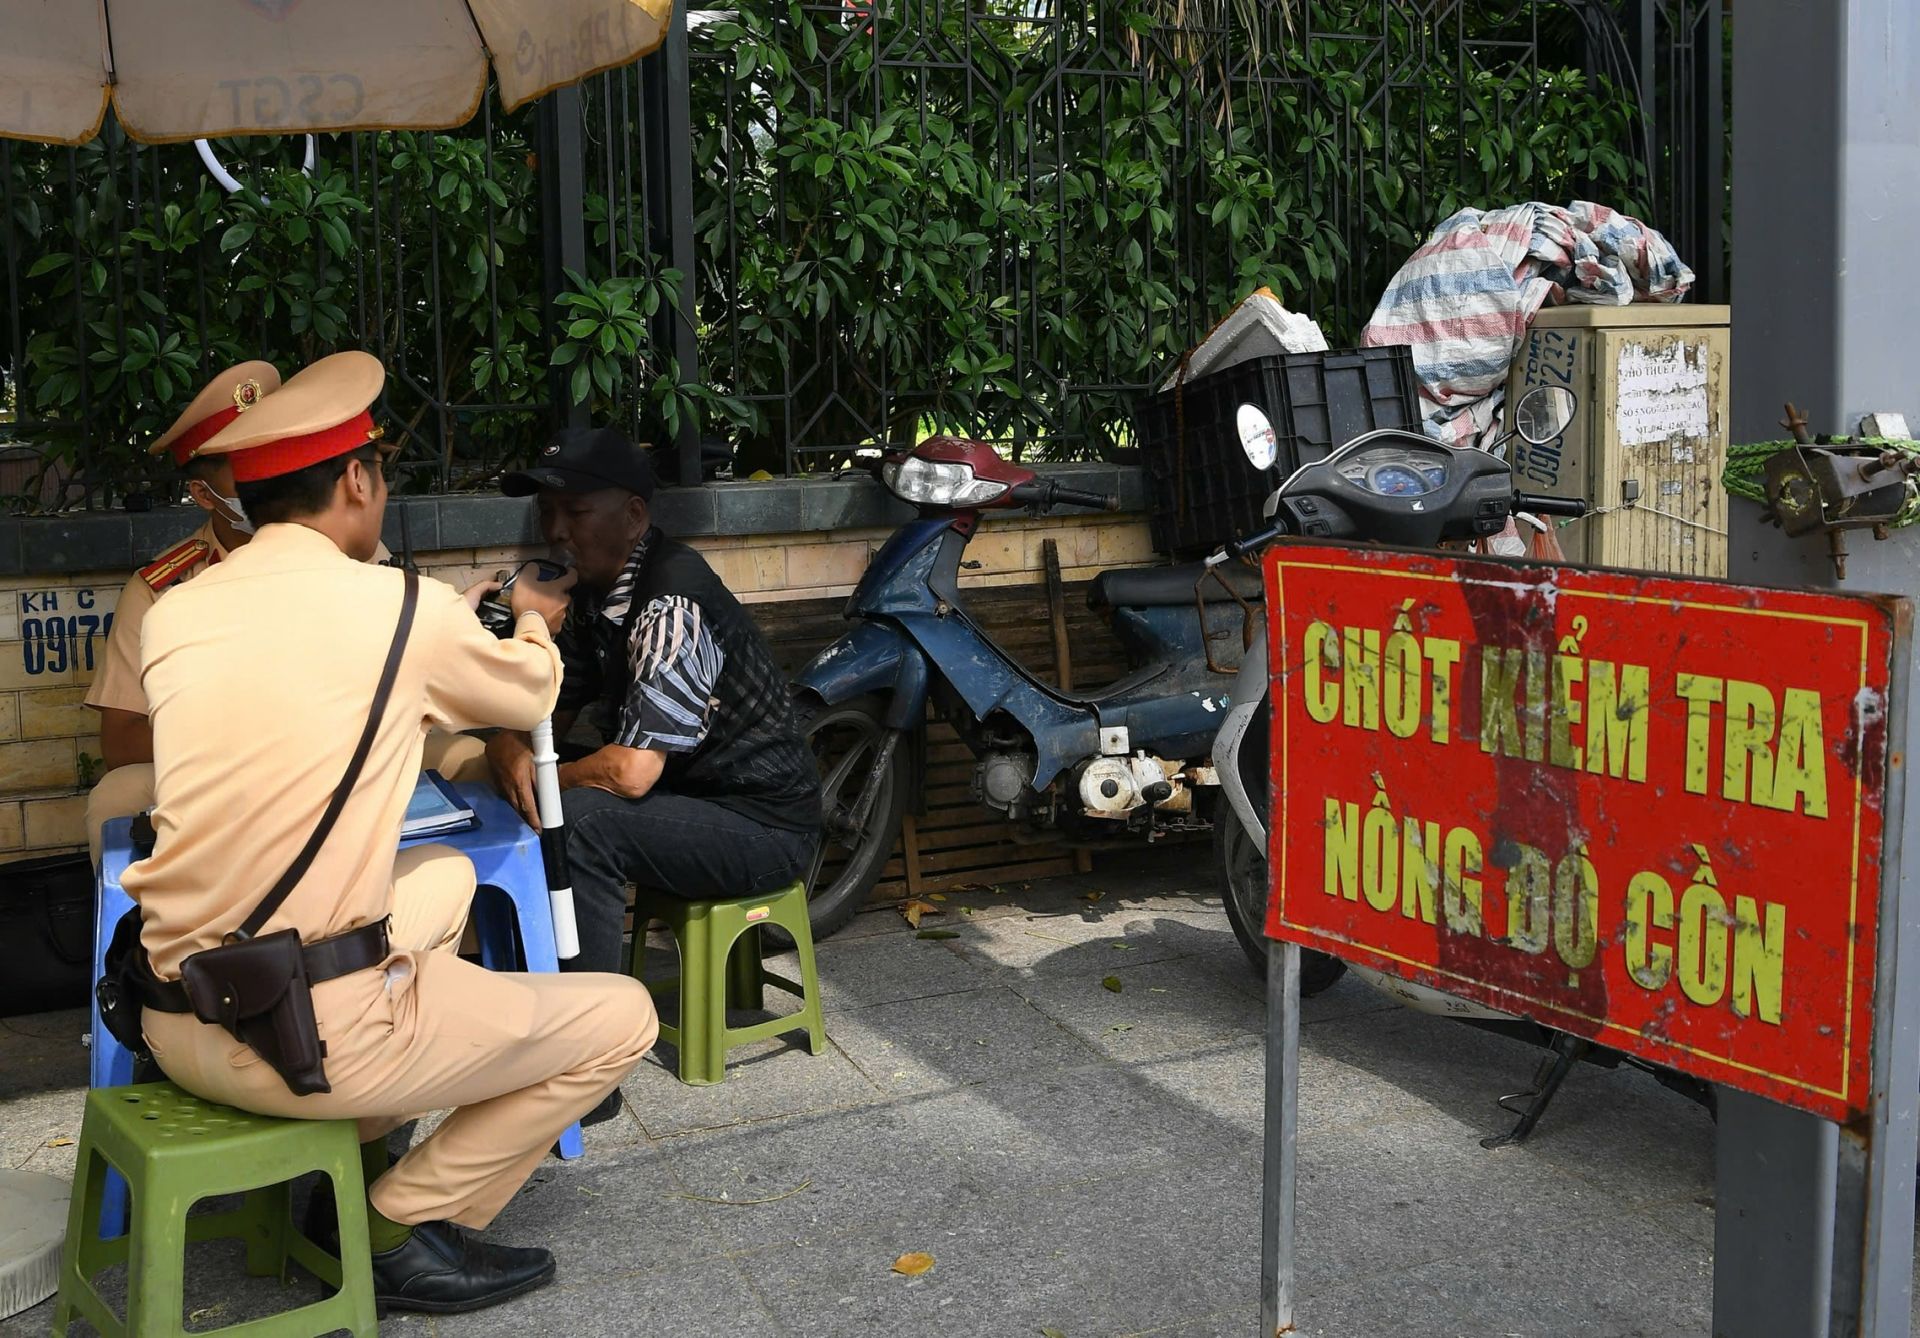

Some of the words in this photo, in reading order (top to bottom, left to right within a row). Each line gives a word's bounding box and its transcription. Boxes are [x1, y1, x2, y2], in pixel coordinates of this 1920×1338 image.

[22, 591, 58, 613] KH
[77, 589, 95, 609] C
[1304, 598, 1460, 744] CHỐT
[1480, 615, 1649, 783] KIỂM
[1676, 672, 1829, 819] TRA
[1324, 770, 1483, 938] NỒNG
[1626, 843, 1786, 1025] CỒN
